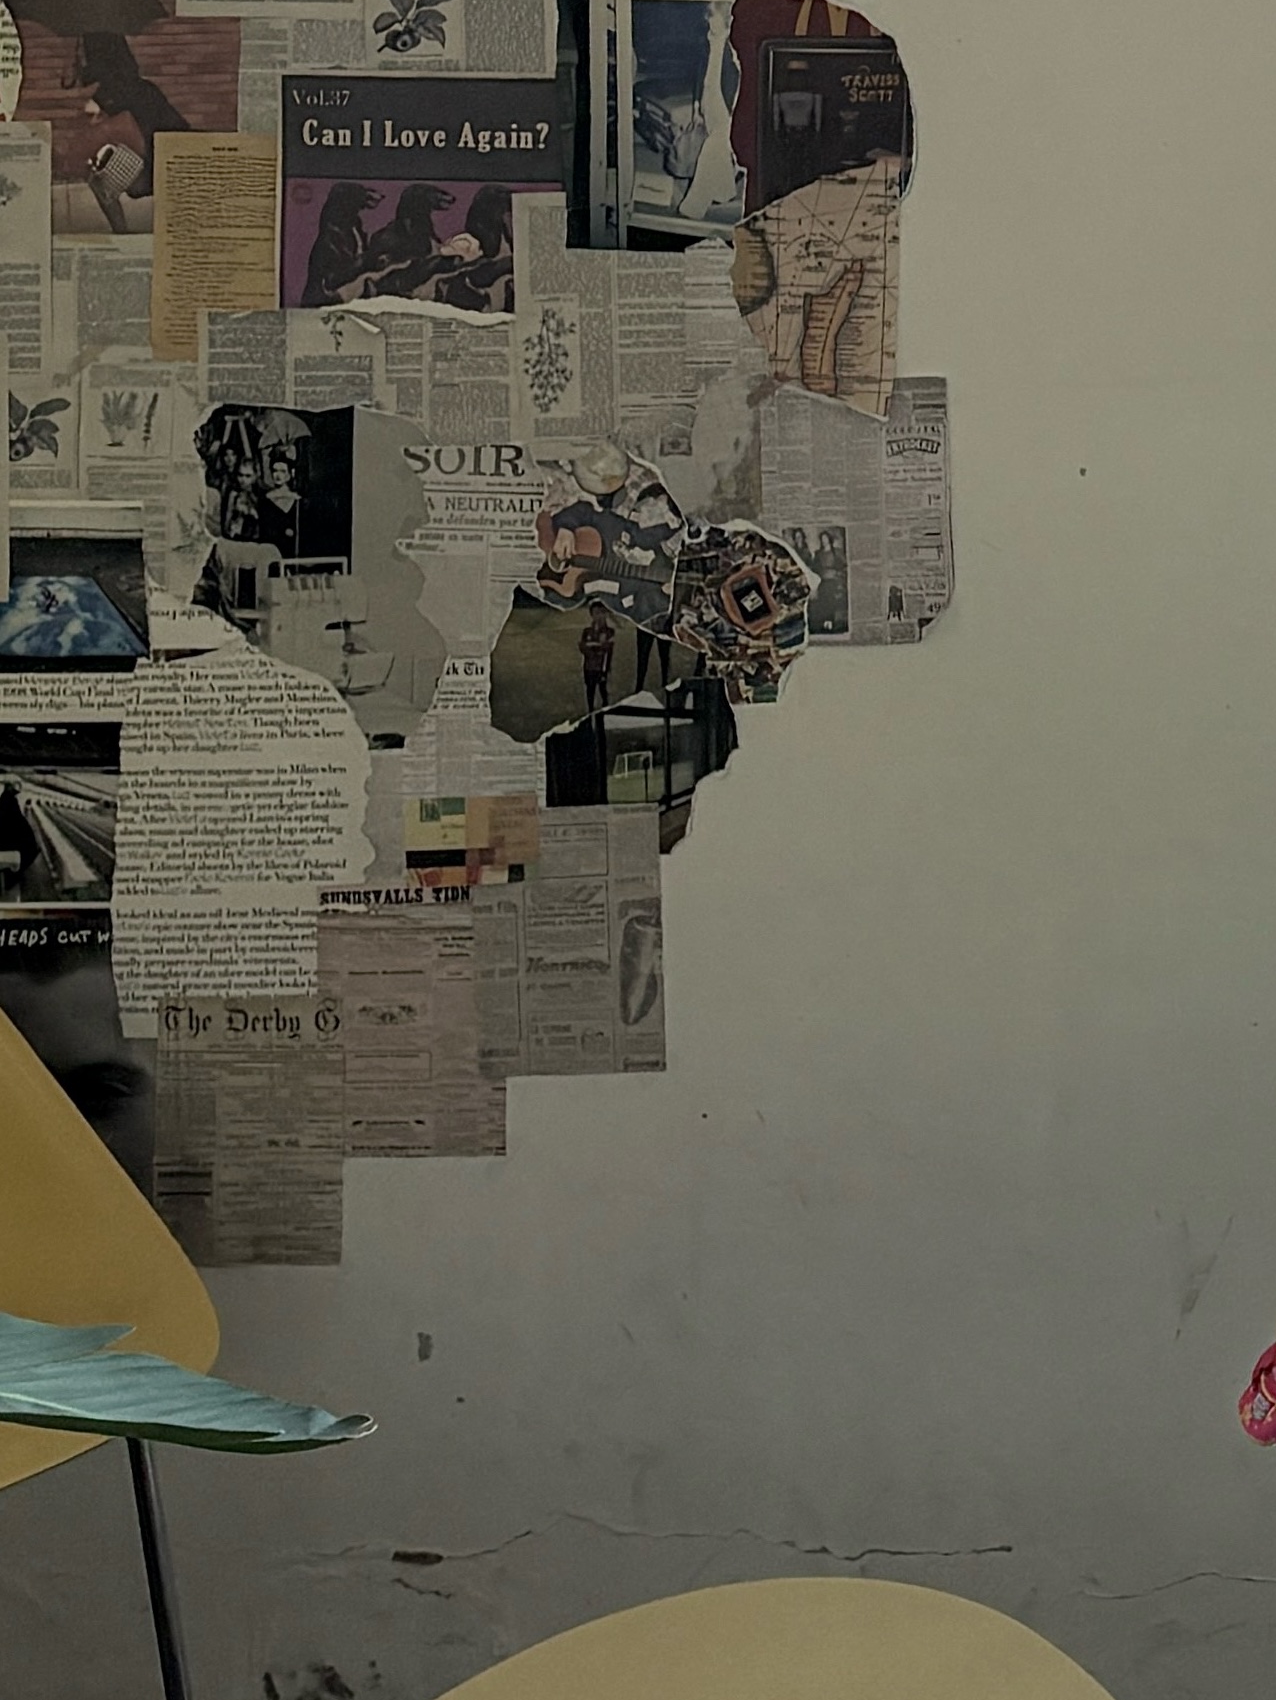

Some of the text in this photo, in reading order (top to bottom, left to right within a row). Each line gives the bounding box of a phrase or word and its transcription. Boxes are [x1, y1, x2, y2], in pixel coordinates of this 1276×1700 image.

[849, 87, 893, 103] SCOTT
[302, 119, 549, 153] Can I Love Again?
[403, 444, 525, 477] SOIR
[165, 1005, 212, 1037] The
[225, 1003, 300, 1039] Derby
